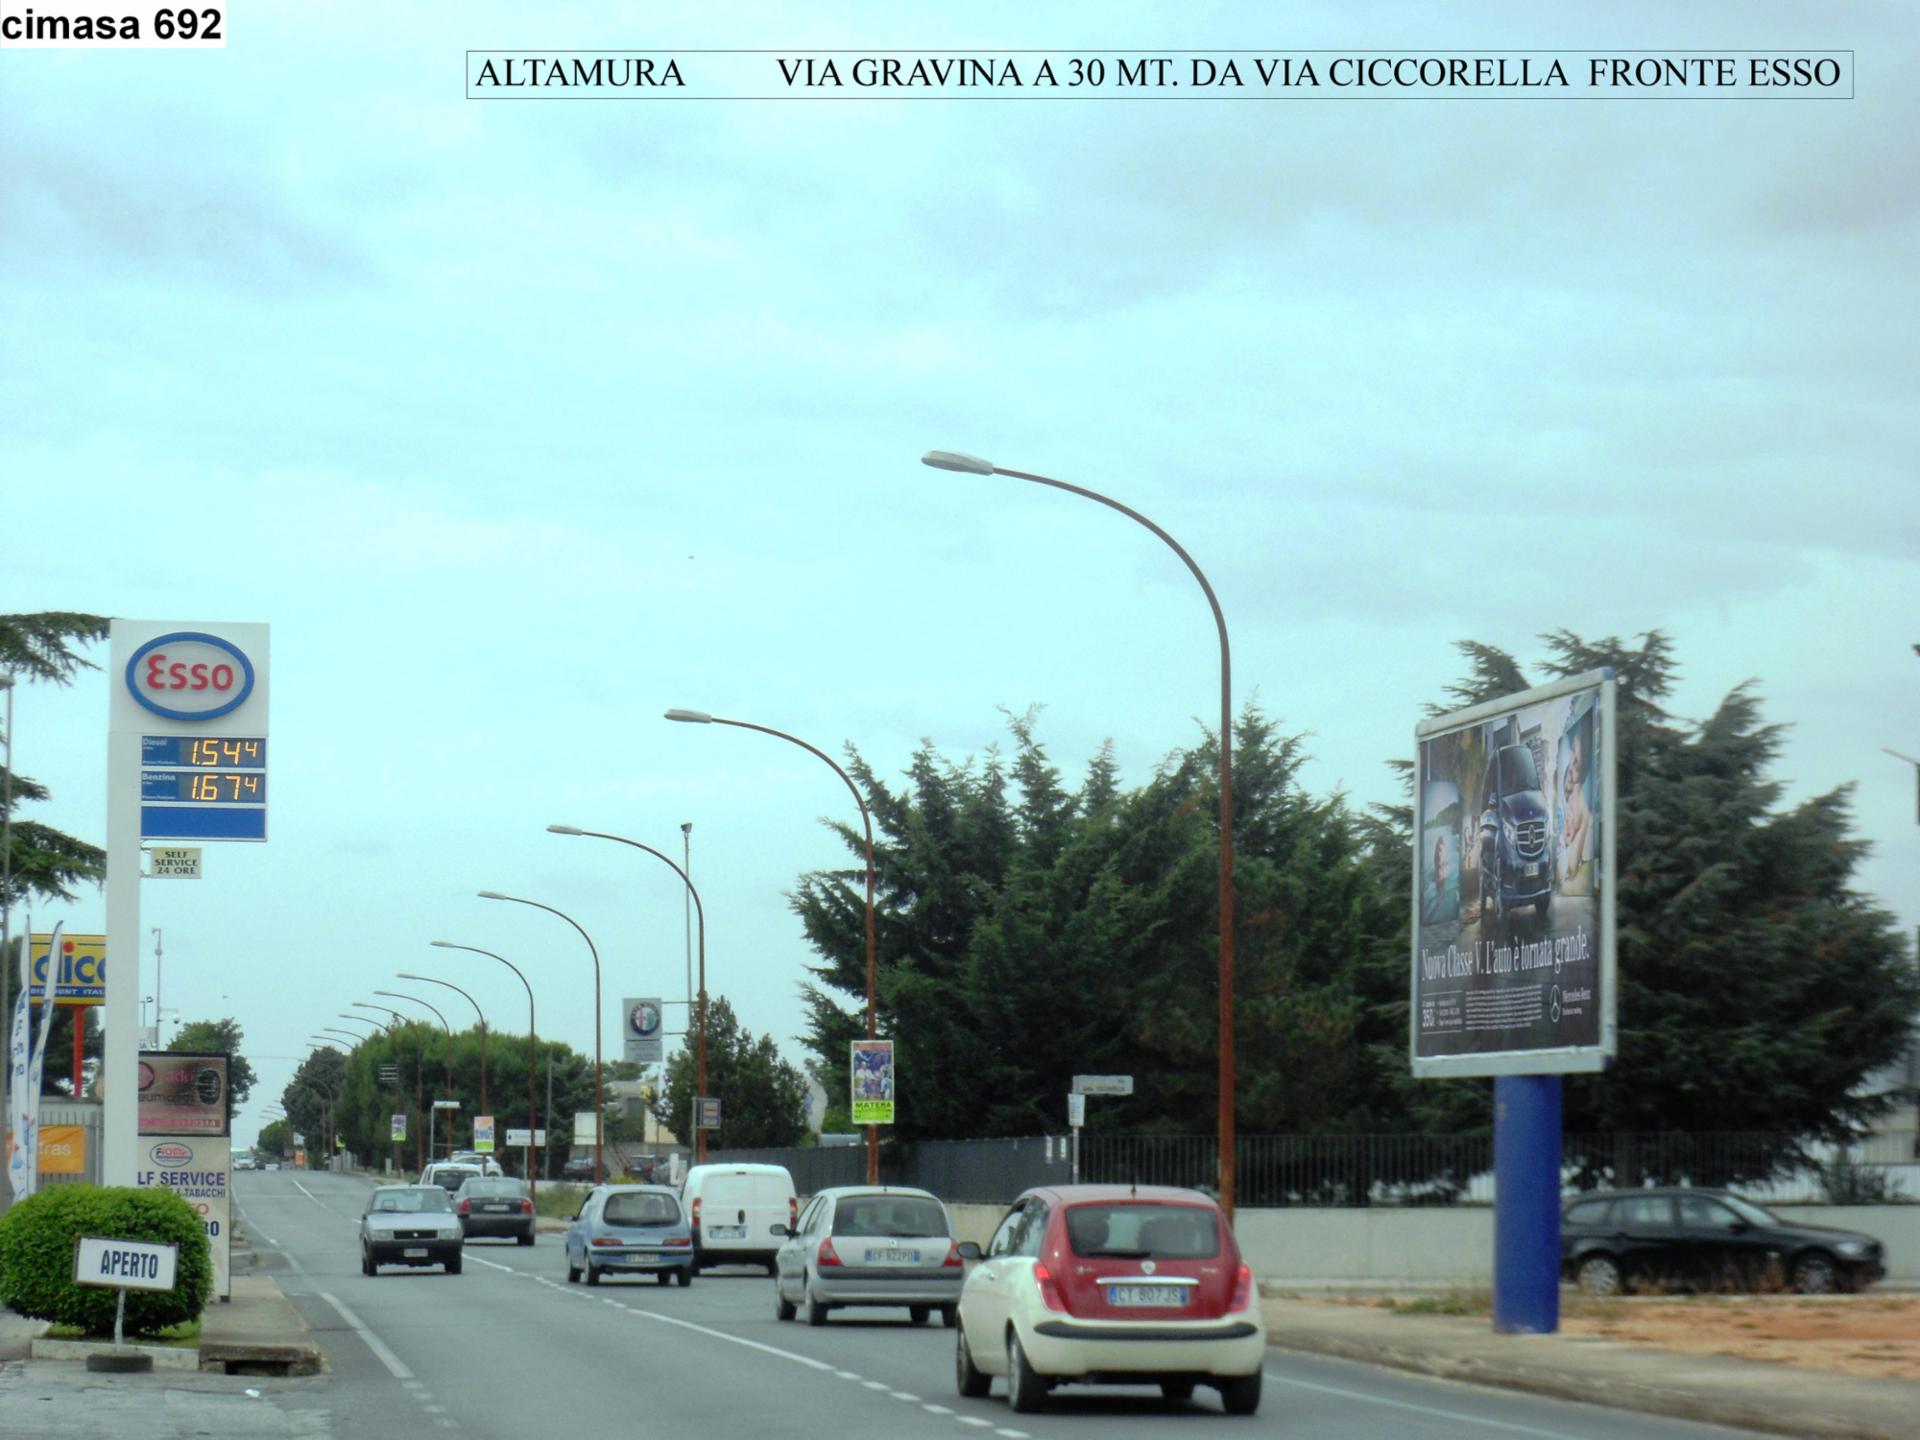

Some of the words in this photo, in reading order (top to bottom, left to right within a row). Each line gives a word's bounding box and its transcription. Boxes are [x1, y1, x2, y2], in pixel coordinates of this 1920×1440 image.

[142, 773, 176, 781] Benzina
[165, 850, 188, 859] SELF
[154, 858, 198, 867] SERVICE
[157, 866, 170, 875] 24
[174, 866, 196, 875] ORE
[1421, 948, 1446, 981] Nuova
[1447, 944, 1473, 978] Classe
[1475, 941, 1485, 975] V.
[1486, 939, 1512, 975] L'auto
[1514, 935, 1520, 971] è
[1521, 936, 1553, 971] tornata
[1554, 924, 1591, 975] grande.
[160, 1171, 225, 1186] SERVICE
[184, 1188, 226, 1198] TABACCHI
[100, 1249, 158, 1279] APERTO
